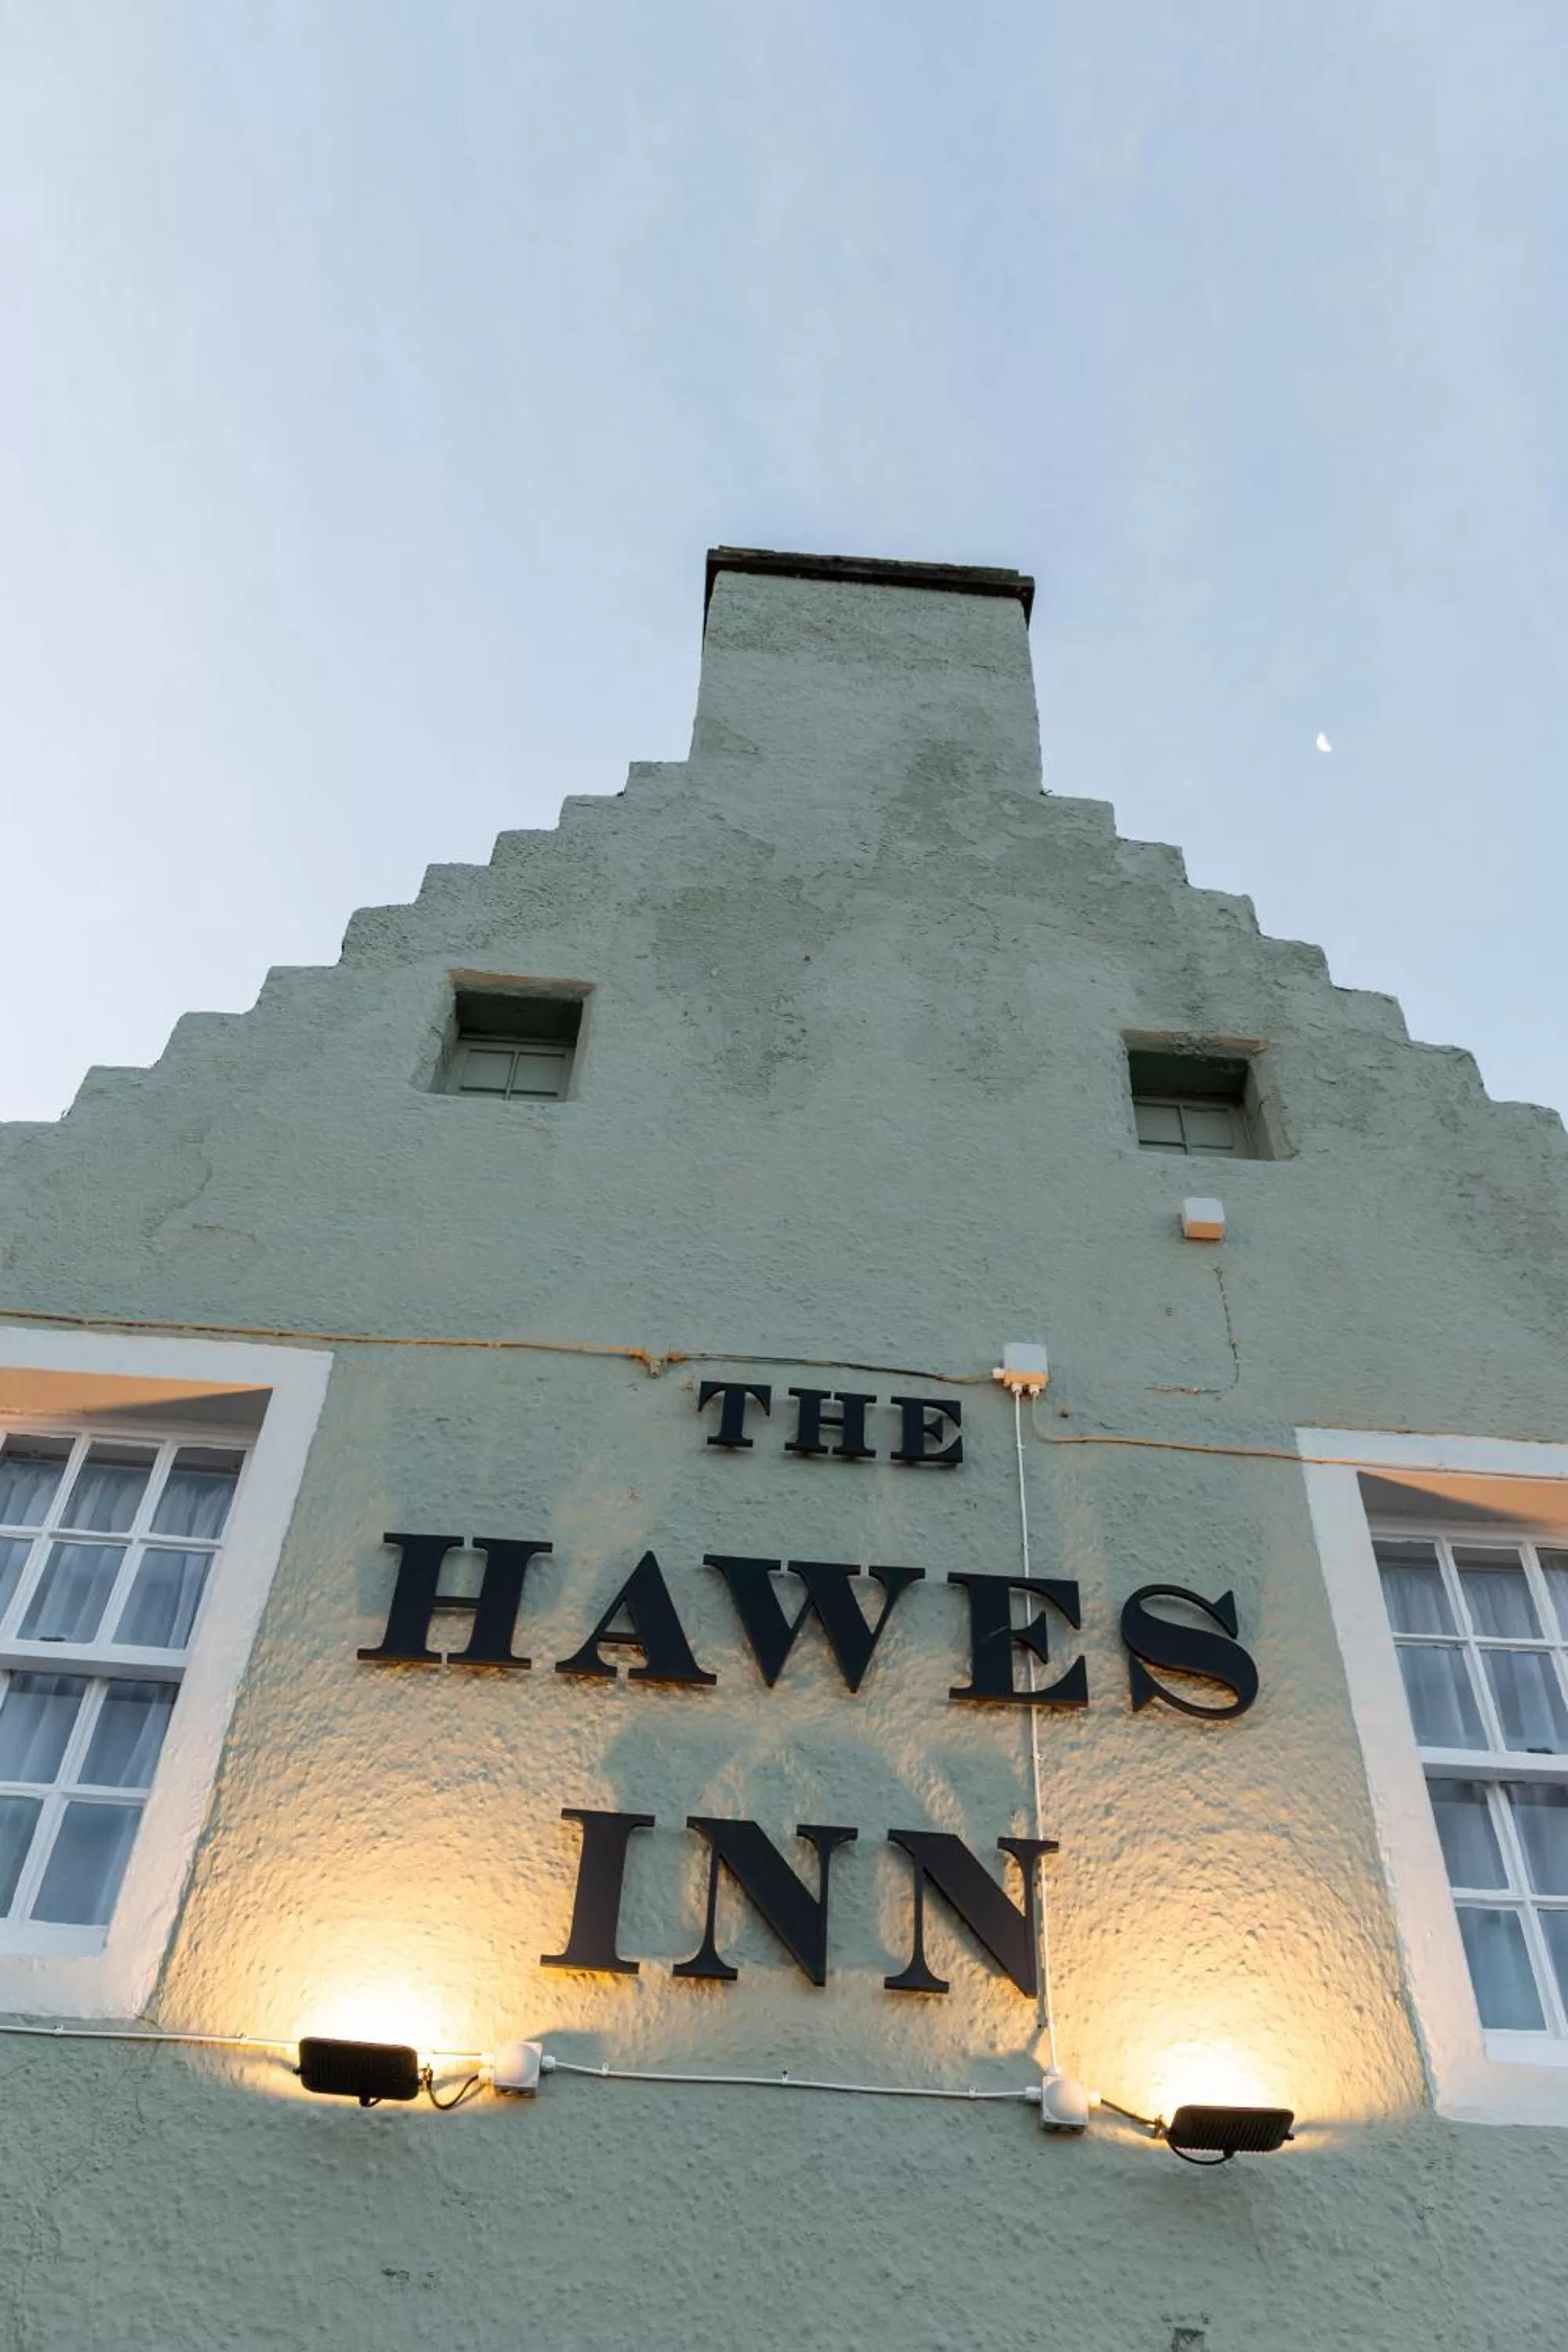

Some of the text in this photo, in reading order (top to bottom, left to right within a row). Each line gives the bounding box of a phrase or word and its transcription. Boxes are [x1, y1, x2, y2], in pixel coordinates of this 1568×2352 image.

[698, 1381, 964, 1465] THE
[357, 1532, 1259, 1719] HAWES
[540, 1809, 1059, 1998] INN
